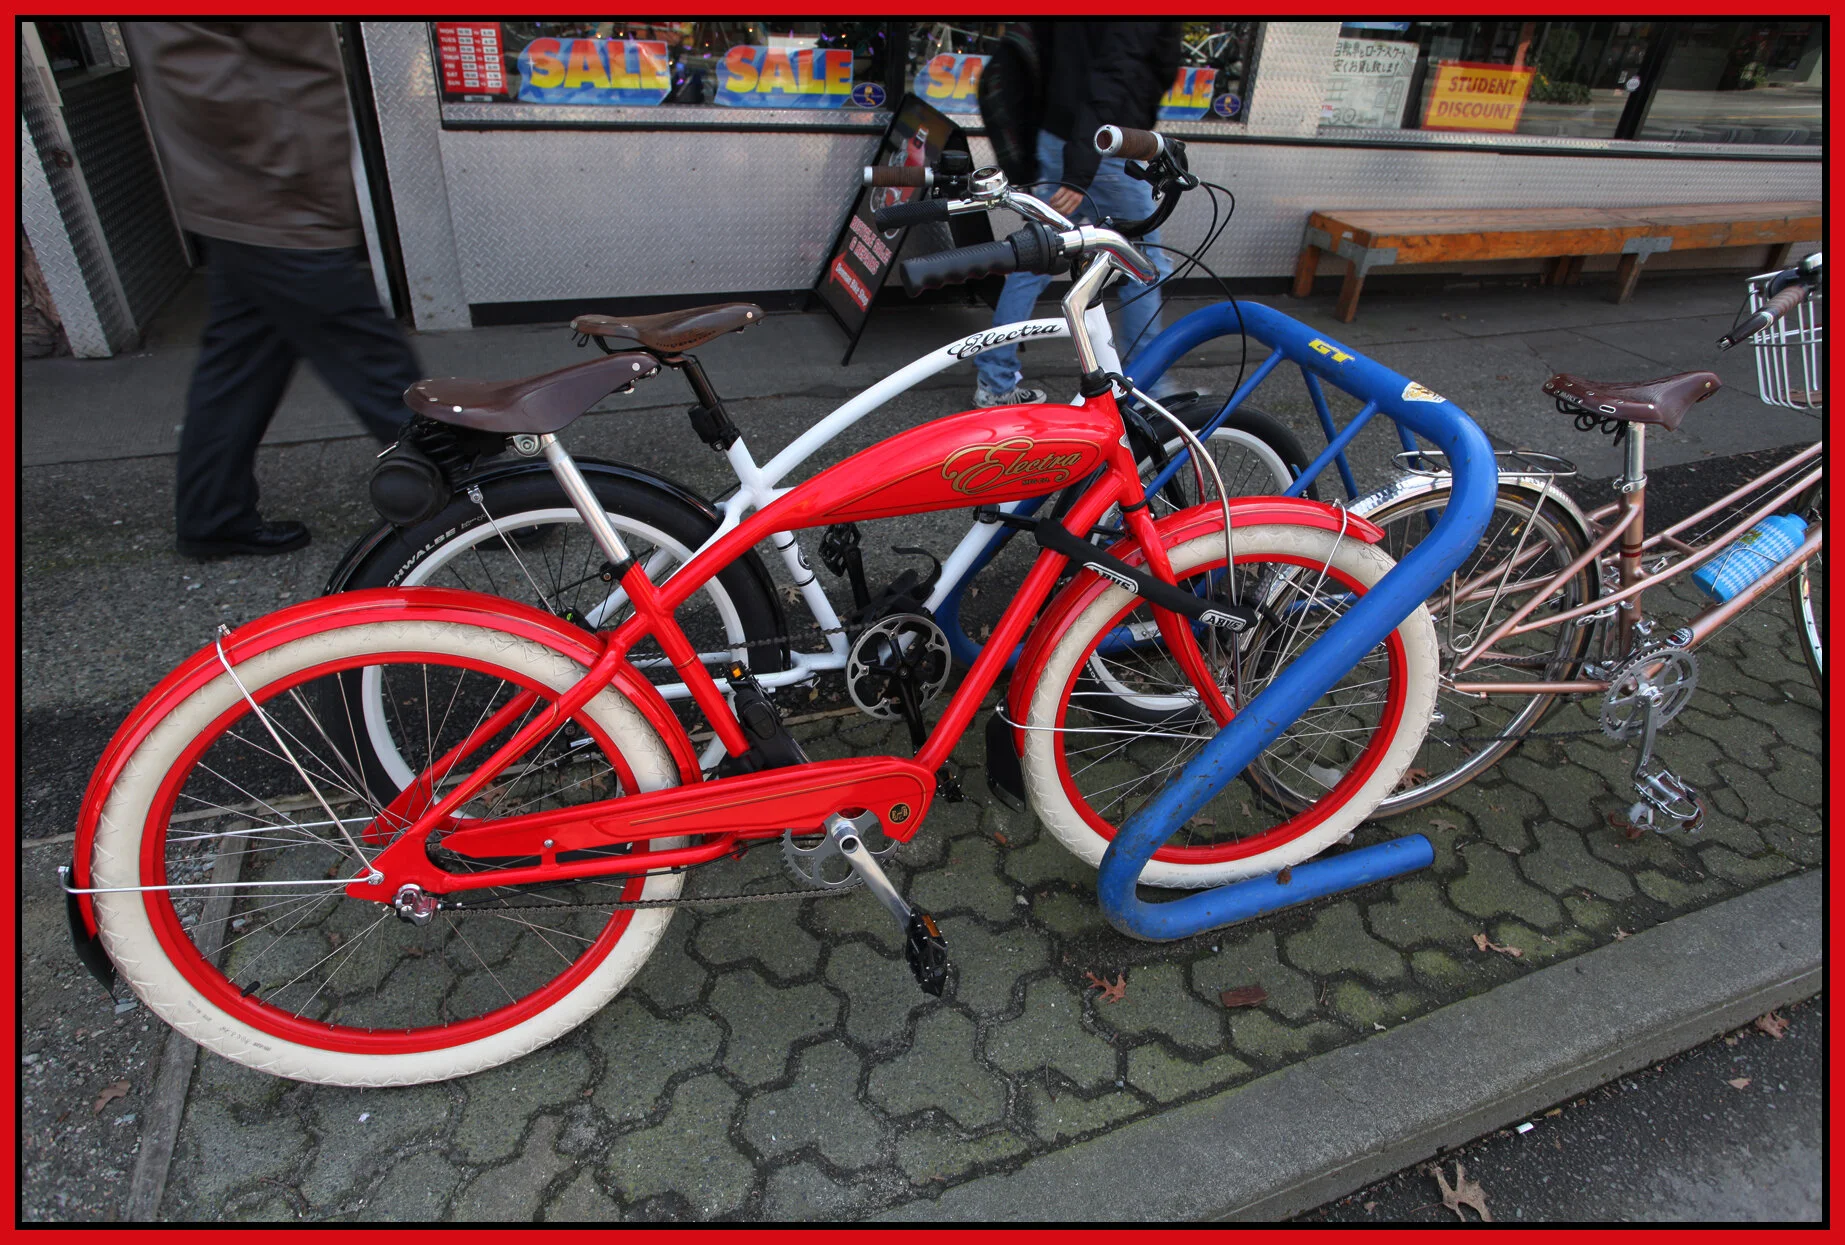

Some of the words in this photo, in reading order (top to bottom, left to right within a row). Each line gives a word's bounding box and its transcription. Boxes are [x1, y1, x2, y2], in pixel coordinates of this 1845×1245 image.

[528, 37, 670, 89] SALE
[723, 45, 854, 95] SALE
[926, 55, 983, 99] SA
[1448, 76, 1517, 95] STUDENT
[1437, 101, 1515, 119] DISCOUNT
[850, 215, 873, 248] BICYCLE
[853, 241, 880, 275] REPAIRS
[850, 279, 860, 295] Bike
[858, 289, 869, 306] Shop
[947, 324, 1062, 360] Electra
[1308, 338, 1355, 363] GT
[942, 437, 1083, 495] Electra
[387, 527, 456, 587] CHWALBE
[1206, 614, 1242, 631] ABUS
